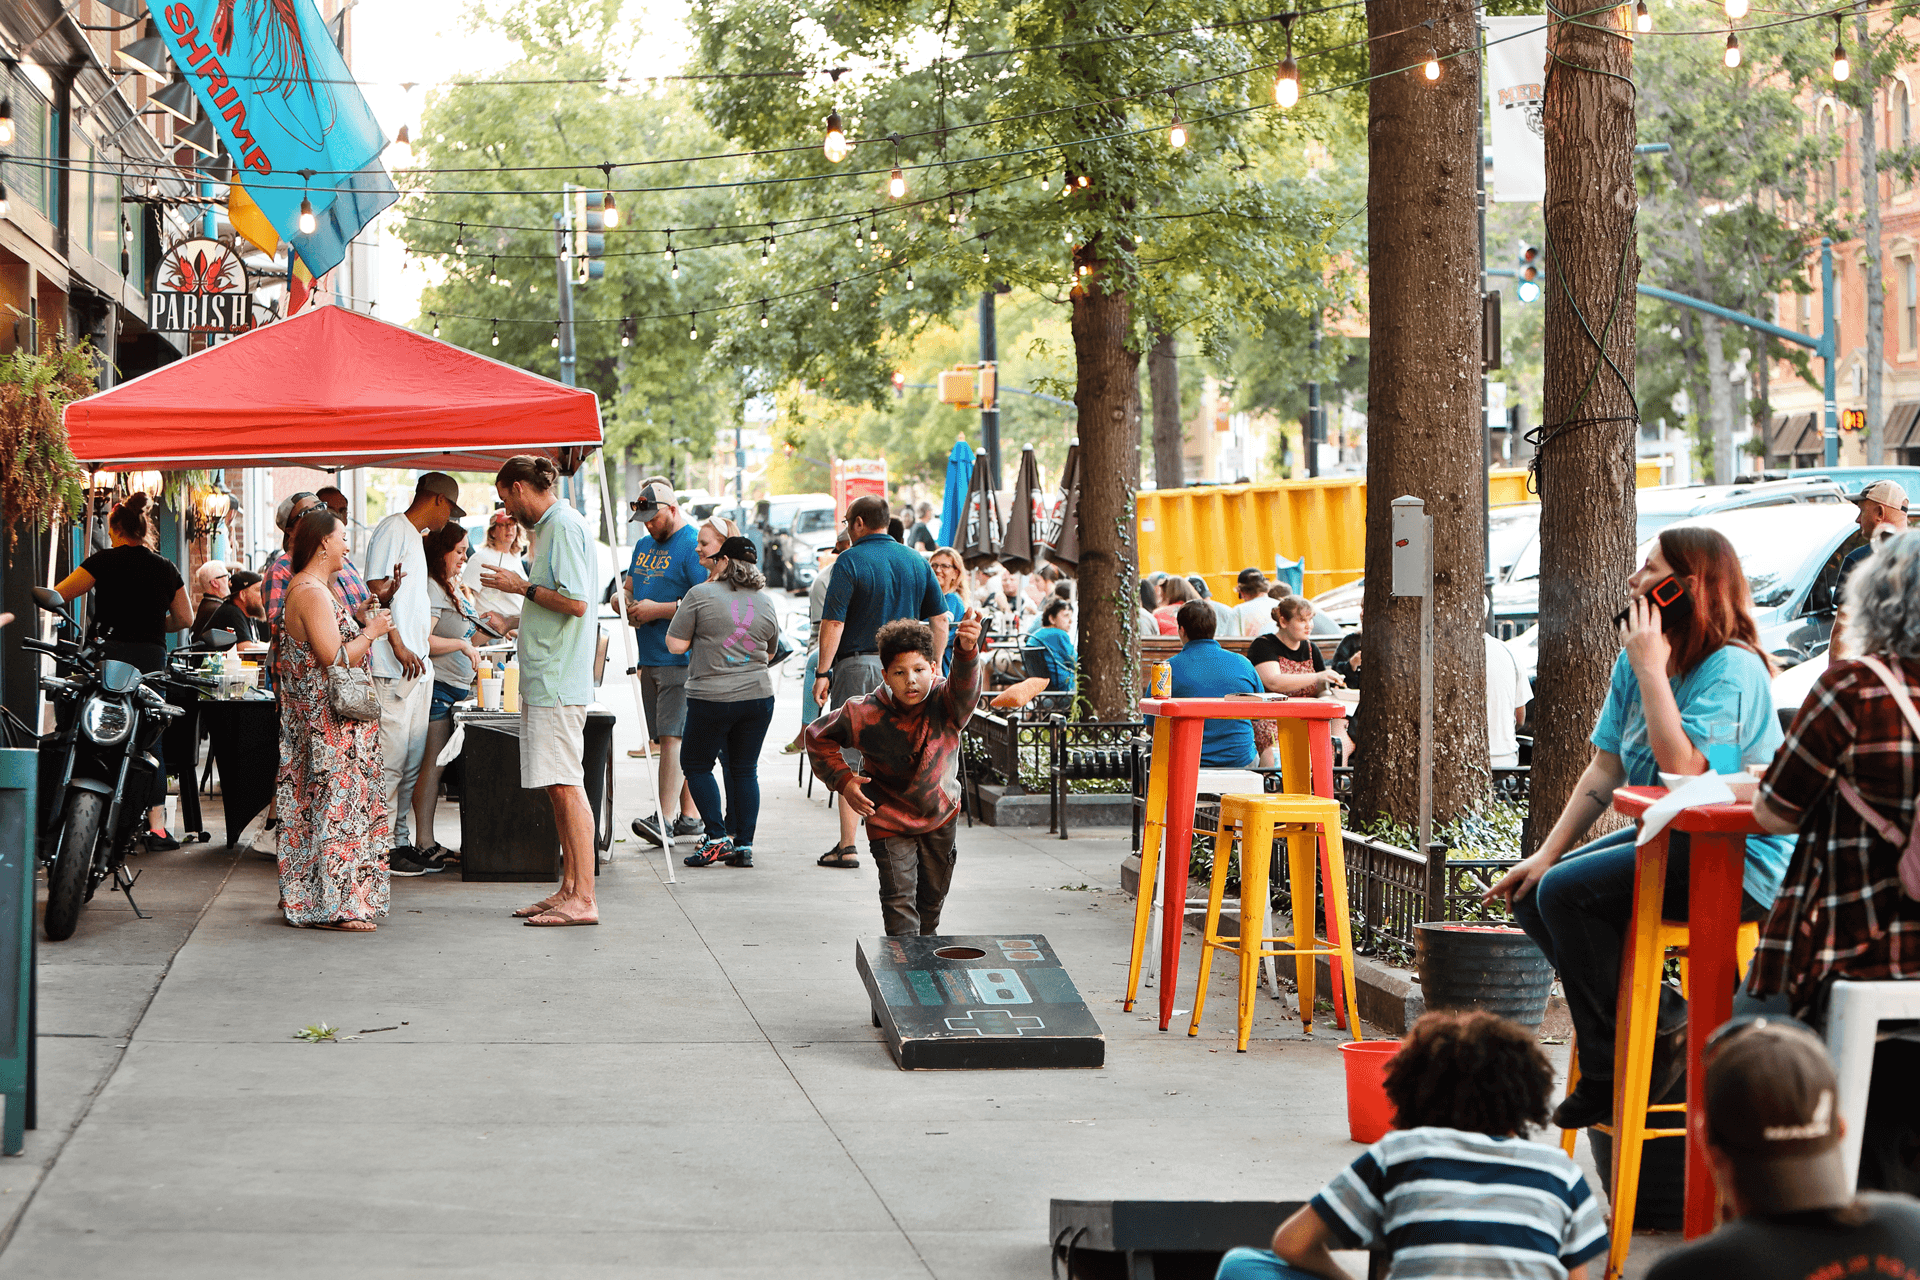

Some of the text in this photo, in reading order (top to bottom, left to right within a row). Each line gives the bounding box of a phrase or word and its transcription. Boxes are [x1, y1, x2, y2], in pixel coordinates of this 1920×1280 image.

[165, 2, 272, 176] SHRIMP
[1498, 83, 1545, 106] MER
[151, 292, 248, 331] PARISH
[635, 552, 672, 570] BLUES
